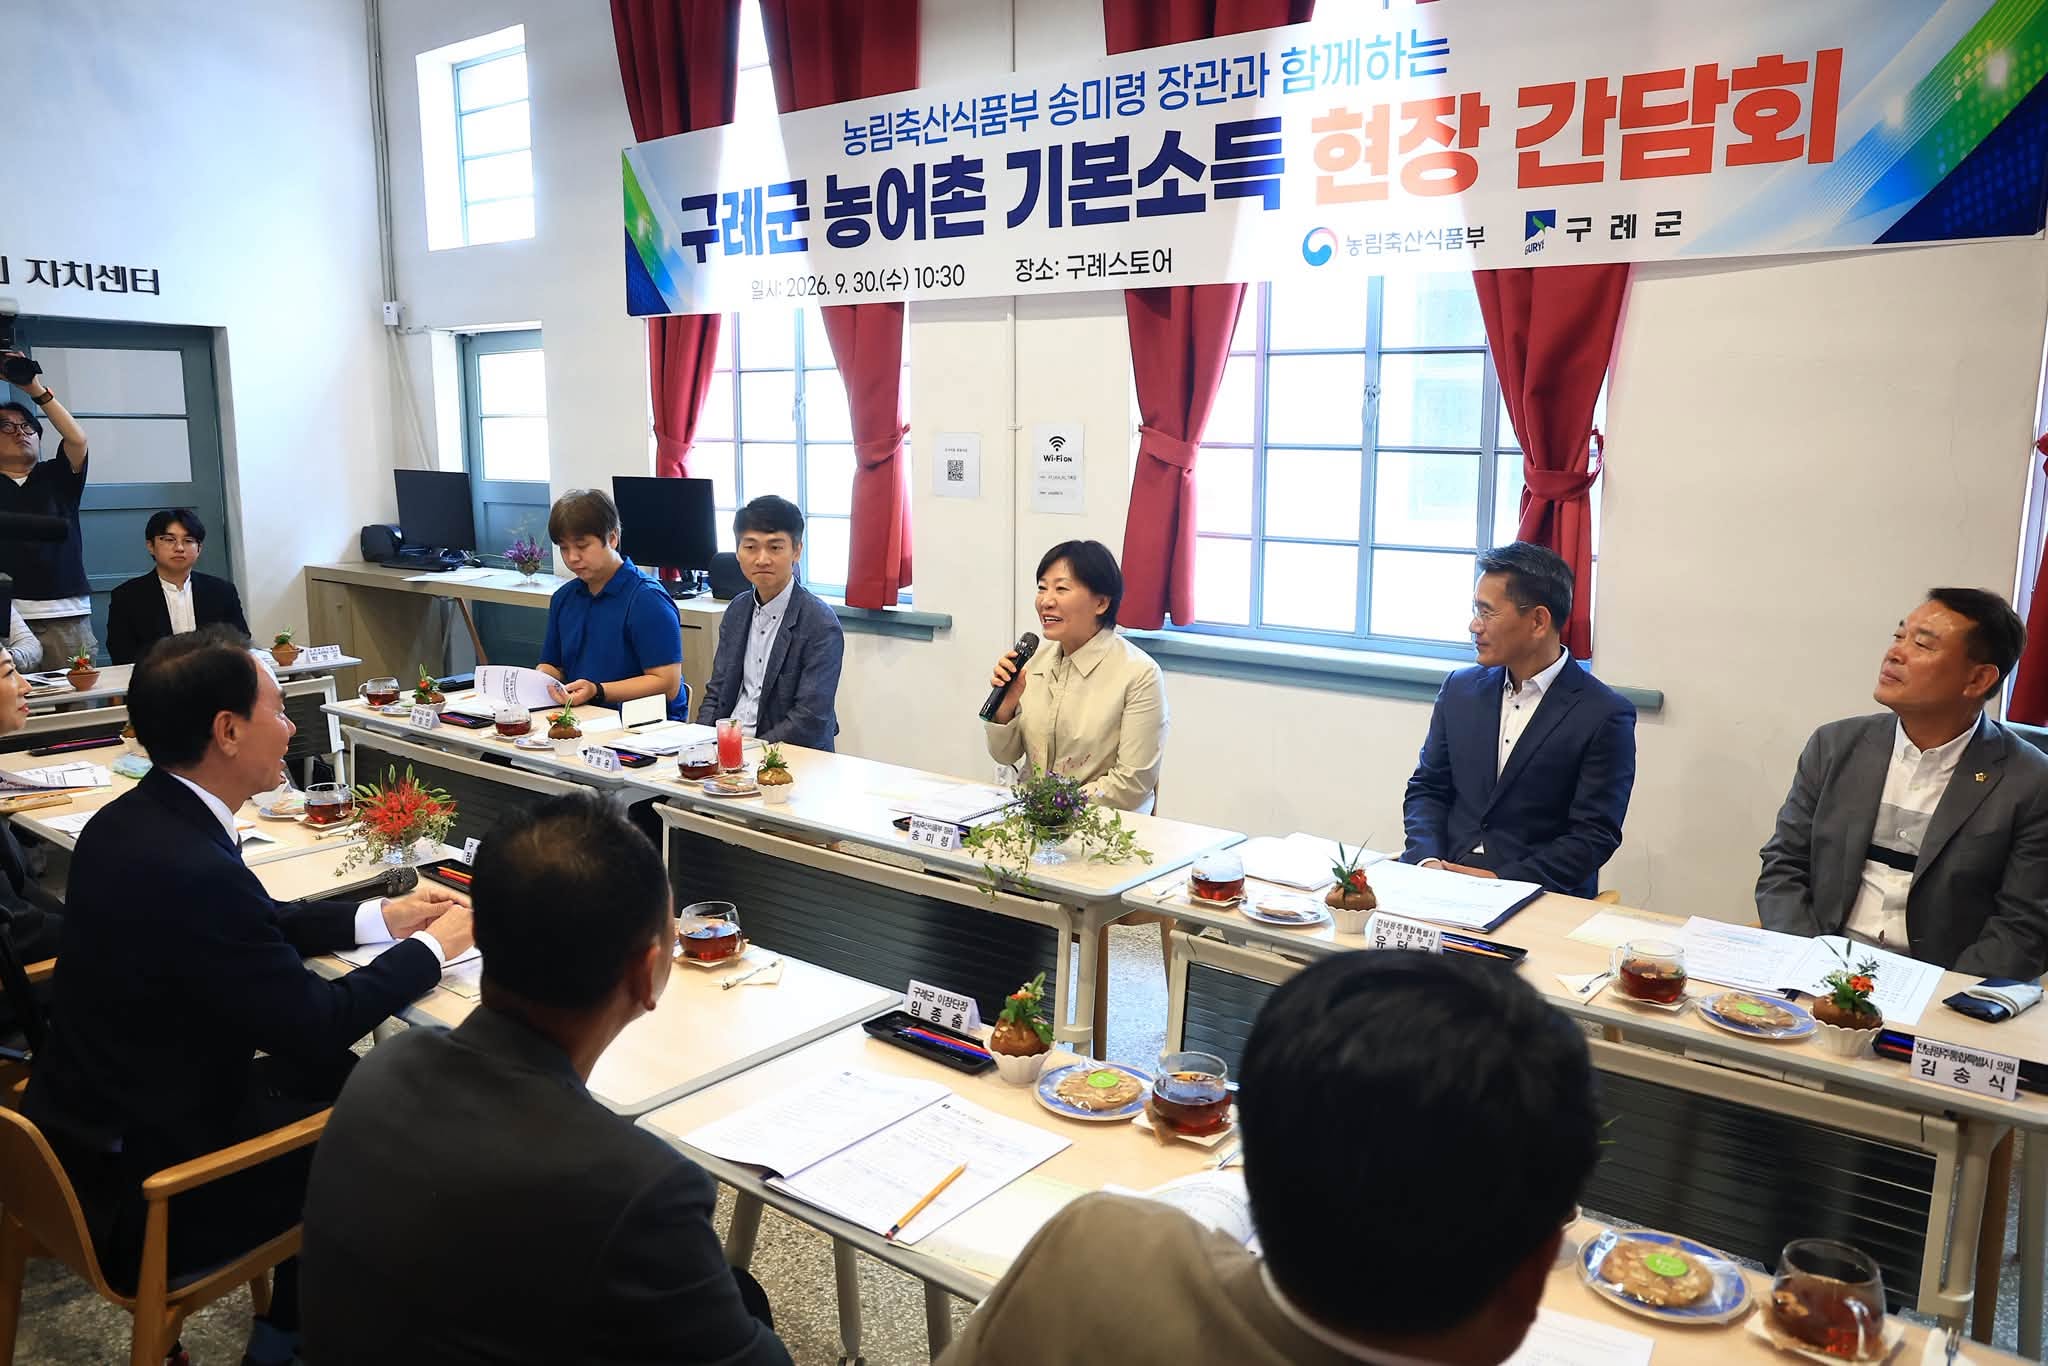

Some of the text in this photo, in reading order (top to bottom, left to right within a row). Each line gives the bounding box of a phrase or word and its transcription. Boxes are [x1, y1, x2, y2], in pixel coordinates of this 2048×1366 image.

[843, 29, 1450, 157] 농림축산식품부 송미령 장관과 함께하는
[681, 47, 1843, 264] 구례군 농어촌 기본소득 현장 간담회
[1346, 226, 1485, 257] 농림축산식품부
[25, 257, 160, 296] 자치센터
[787, 275, 831, 297] 2026.
[914, 264, 965, 289] 10:30
[1015, 247, 1172, 282] 장소: 구례스토어
